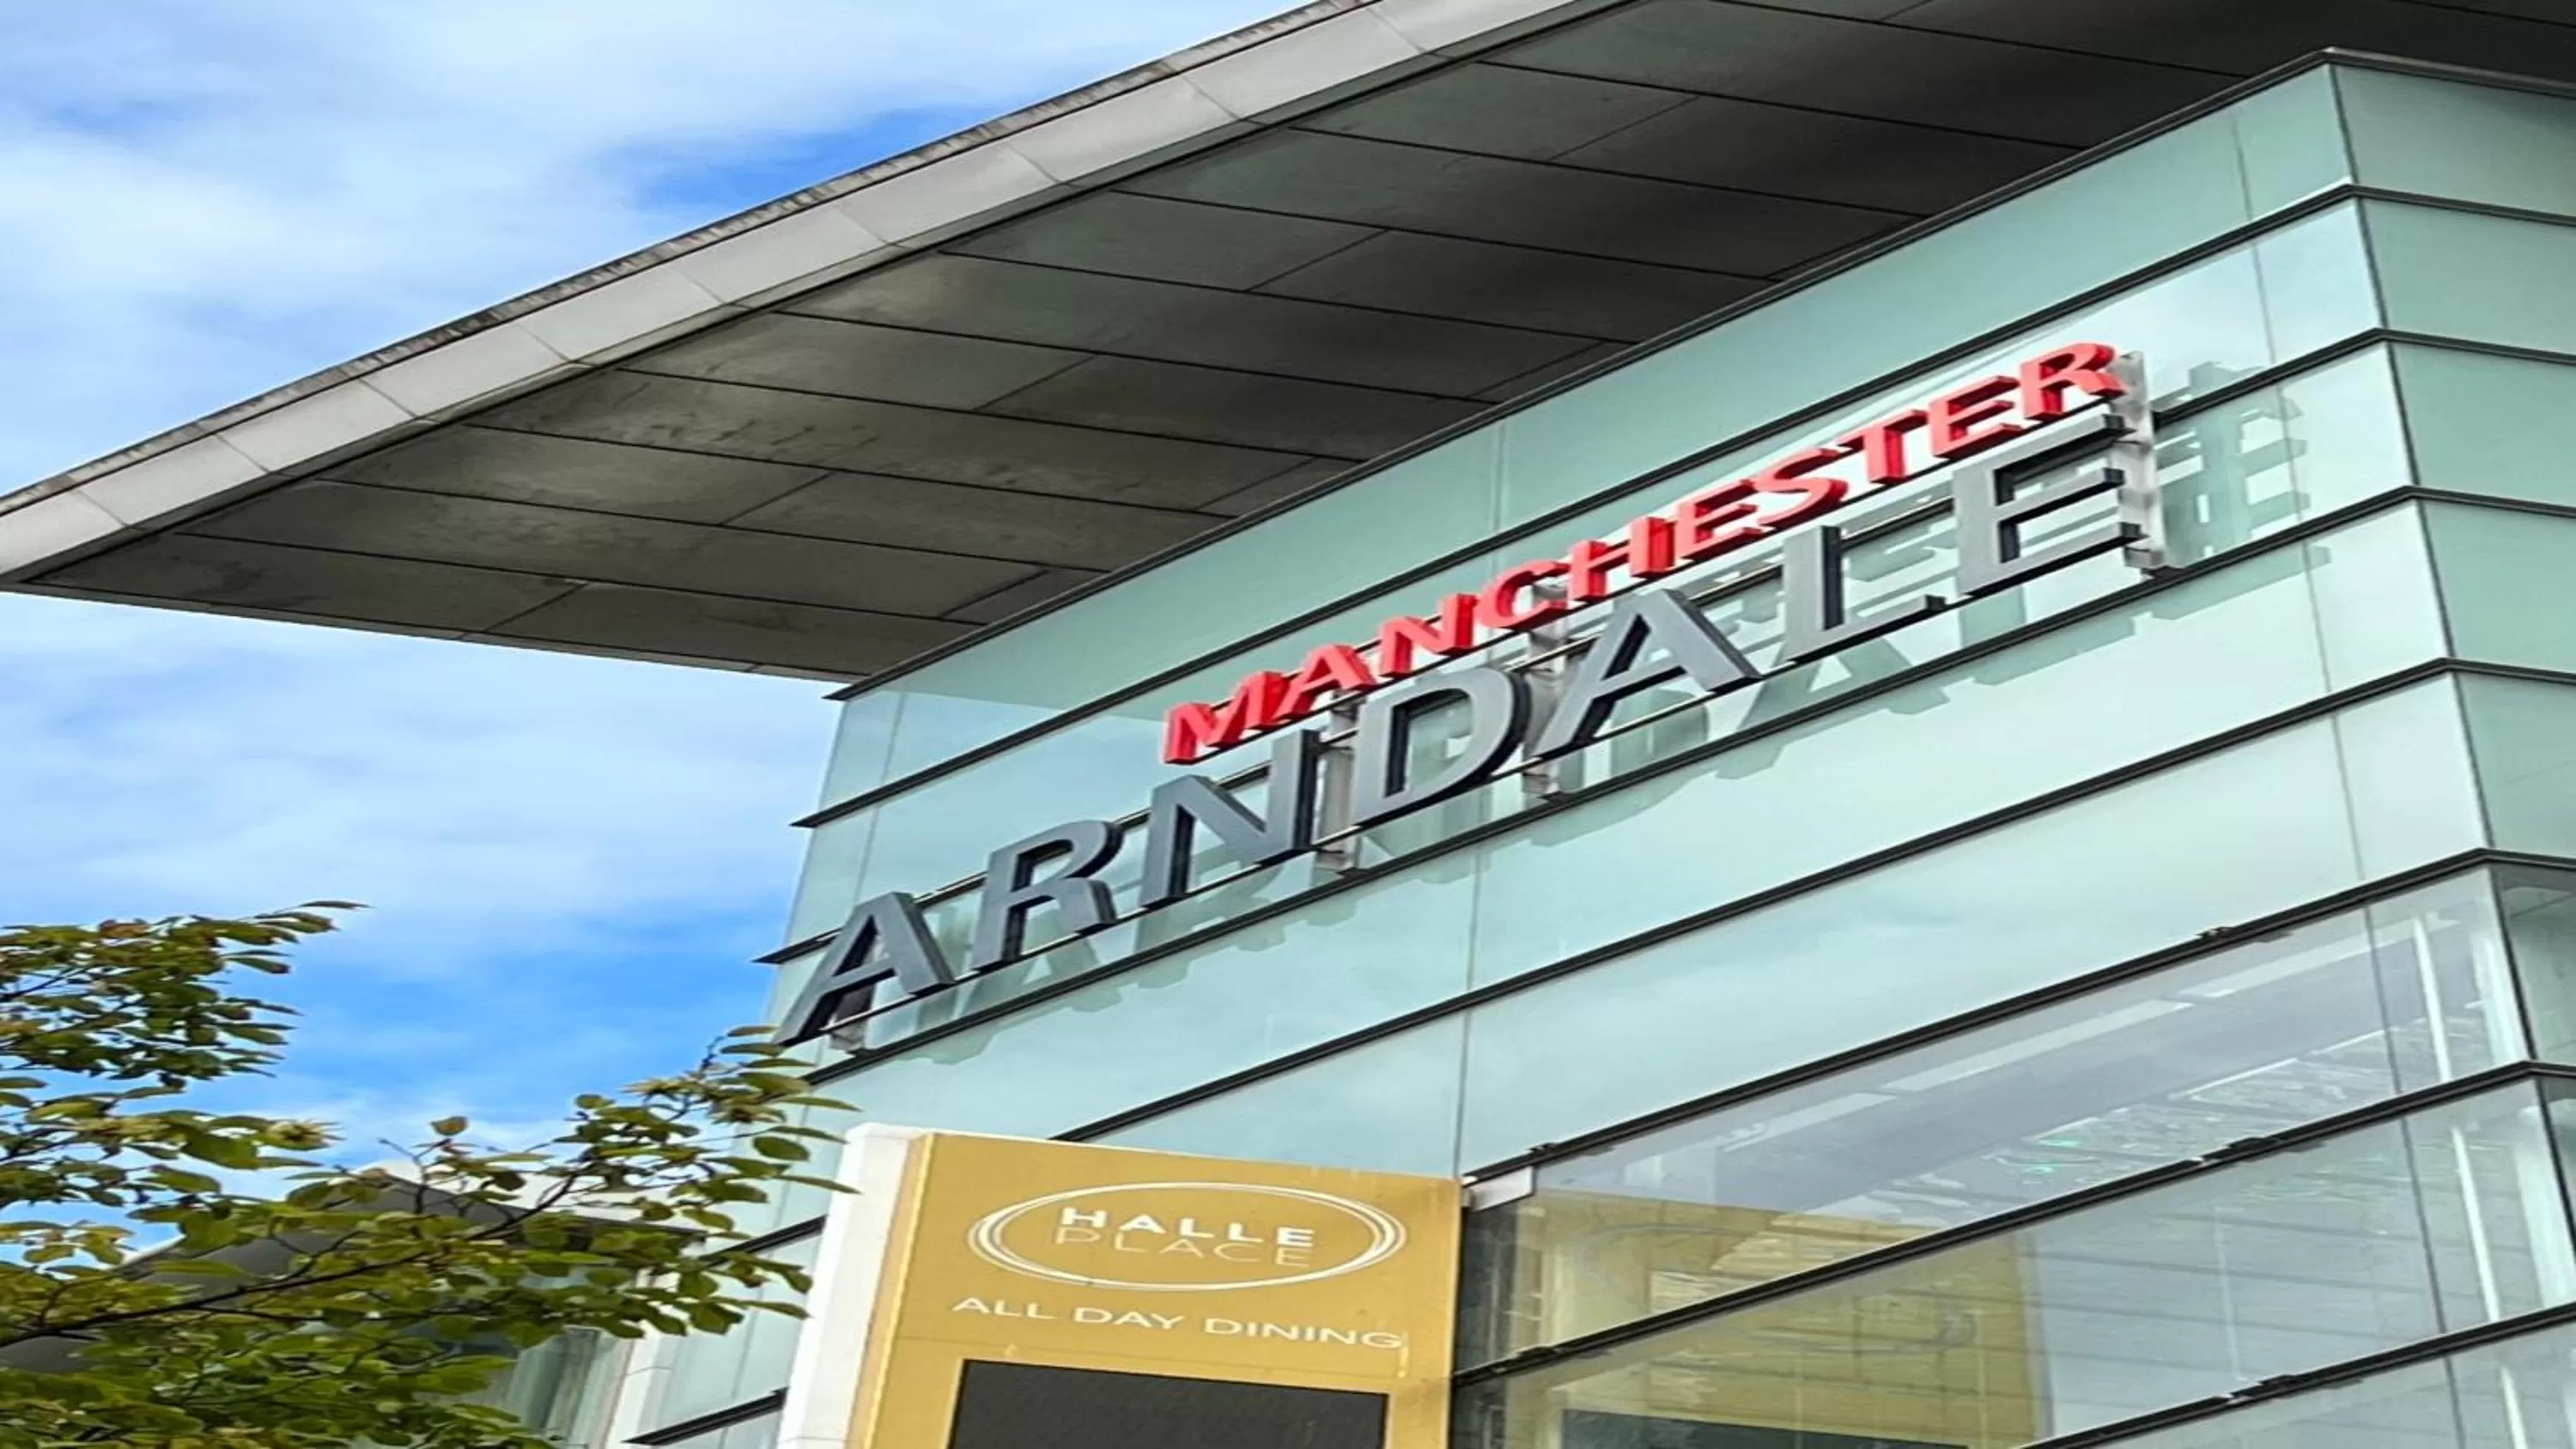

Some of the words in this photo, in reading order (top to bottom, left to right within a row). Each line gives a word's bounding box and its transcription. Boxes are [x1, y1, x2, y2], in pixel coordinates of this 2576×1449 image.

[1164, 343, 2125, 765] MANCHESTER
[775, 411, 2148, 1048] ARNDALE
[1054, 1226, 1313, 1268] PLACE
[1060, 1207, 1315, 1247] HALLE
[951, 1296, 1055, 1319] ALL
[1073, 1307, 1184, 1330] DAY
[1205, 1318, 1403, 1349] DINING
